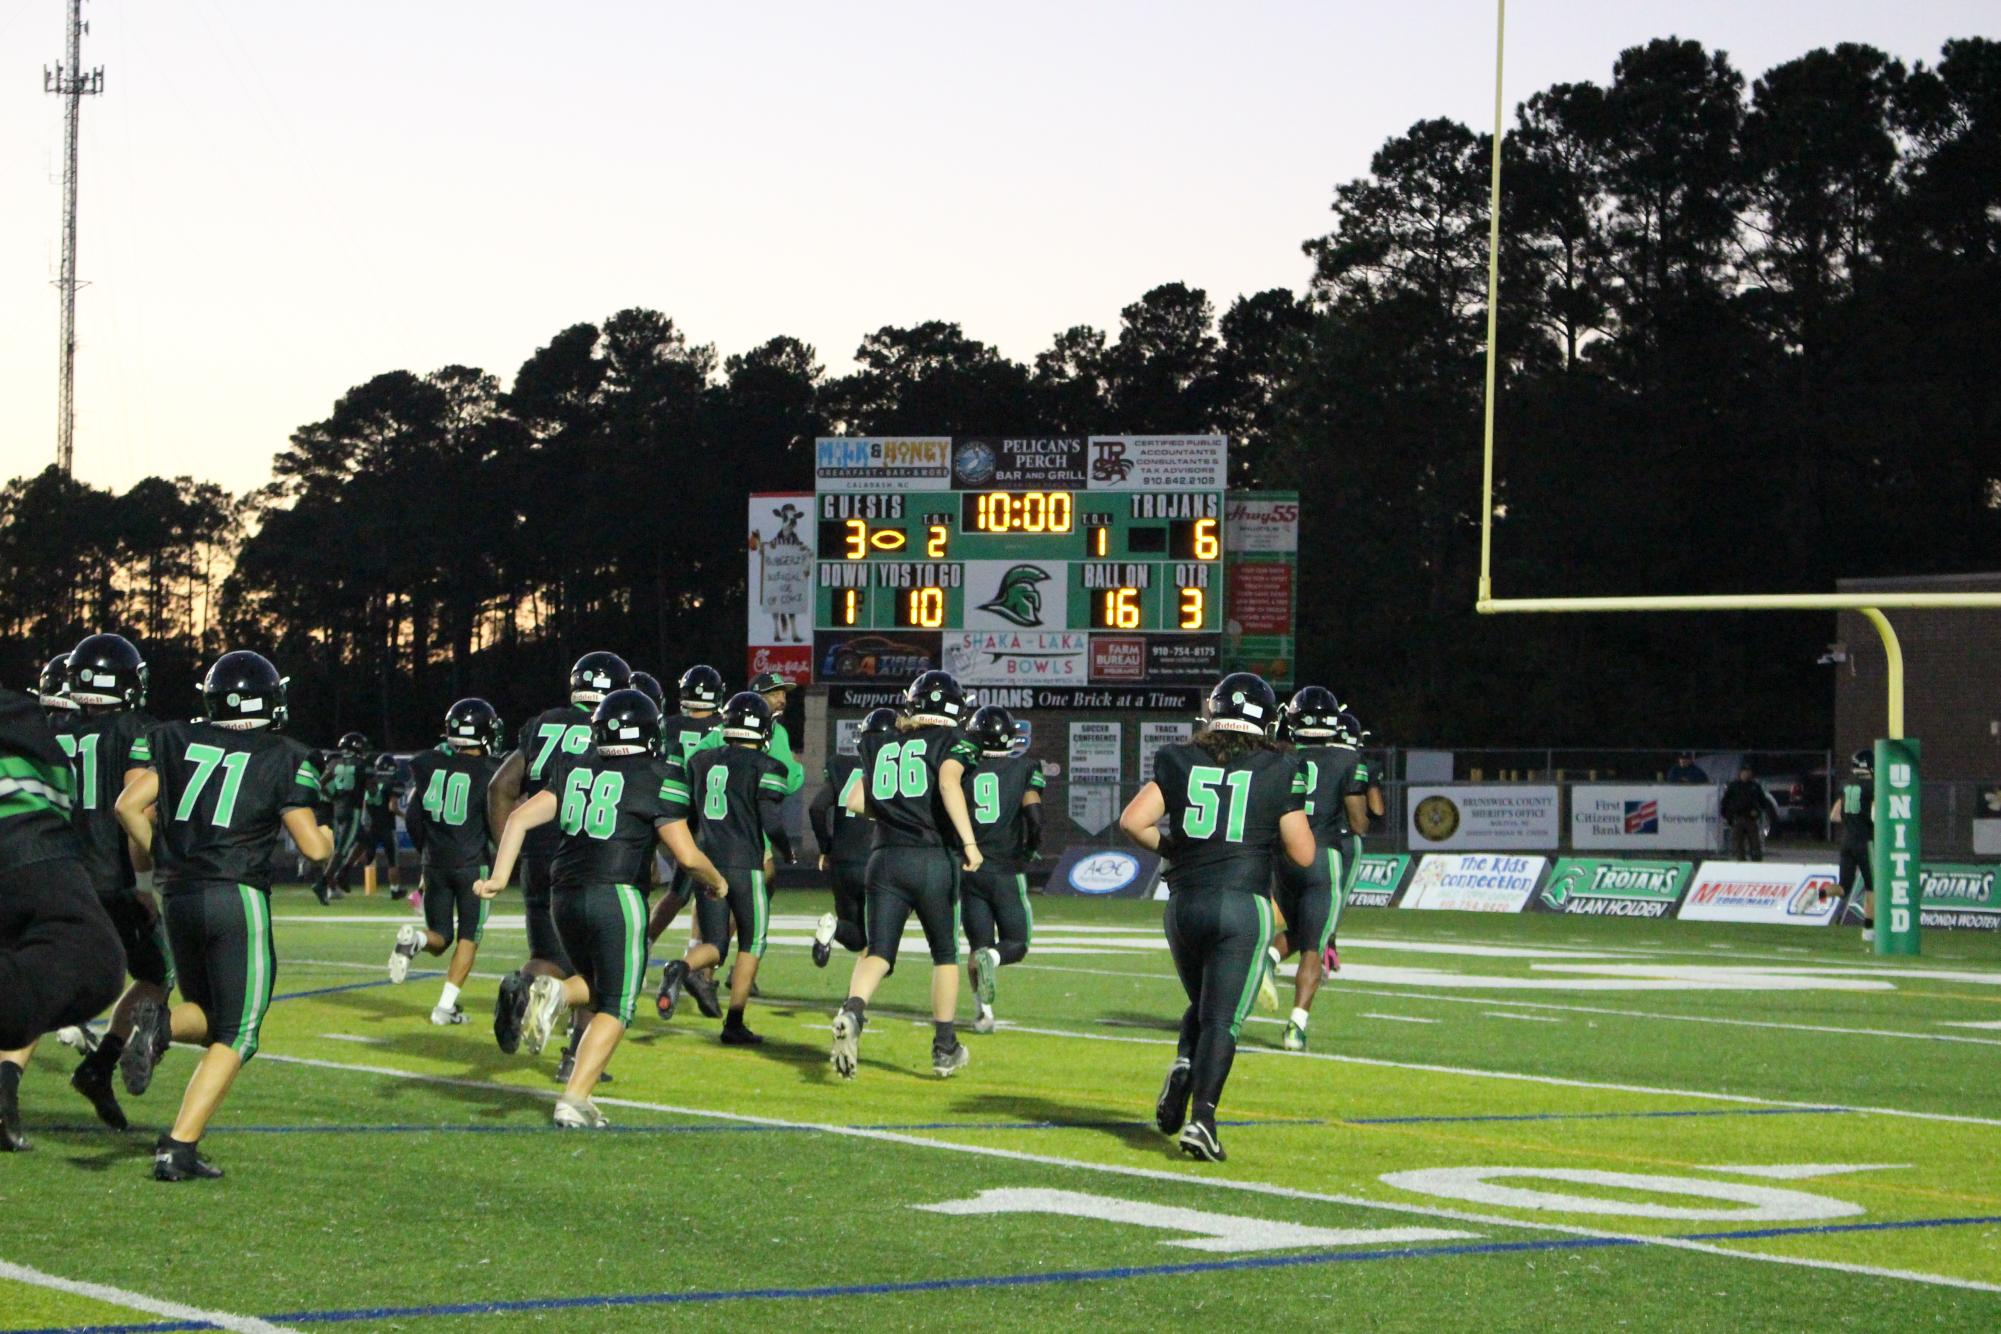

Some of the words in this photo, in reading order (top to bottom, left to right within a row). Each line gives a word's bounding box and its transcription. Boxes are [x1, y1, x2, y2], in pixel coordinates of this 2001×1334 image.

[871, 443, 882, 458] &
[884, 441, 950, 467] HONEY
[1003, 439, 1081, 453] PELICAN'S
[818, 468, 878, 477] BREAKFAST
[886, 468, 908, 477] BAR
[1016, 454, 1067, 468] PERCH
[995, 470, 1022, 480] BAR
[1024, 472, 1046, 480] AND
[1047, 470, 1086, 480] GRILL
[823, 495, 902, 519] GUESTS
[977, 492, 1071, 532] 10:00
[1131, 493, 1218, 518] TROJANS
[845, 519, 866, 560] 3
[927, 526, 947, 558] 2
[1098, 527, 1107, 556] 1
[1194, 519, 1218, 560] 6
[820, 563, 868, 588] DOWN
[880, 563, 911, 588] YDS
[915, 563, 935, 588] TO
[939, 563, 961, 588] GO
[1084, 563, 1121, 588] BALL
[1125, 563, 1149, 588] ON
[1175, 563, 1208, 588] QTR
[846, 589, 855, 625] 1
[910, 587, 943, 628] 10
[1105, 588, 1139, 629] 16
[1181, 588, 1203, 629] 3
[1096, 655, 1140, 665] BUREAU
[1108, 643, 1140, 655] FARM
[1152, 646, 1216, 656] 910-754-8175
[1007, 660, 1073, 674] BOWLS
[966, 688, 1034, 708] ROJANS
[1039, 691, 1069, 707] One
[1073, 691, 1113, 707] Brick
[1116, 692, 1132, 707] at
[1135, 696, 1144, 707] a
[1149, 691, 1186, 707] Time
[1073, 734, 1117, 742] CONFERENCE
[1081, 724, 1109, 733] SOCCER
[1155, 725, 1178, 733] TRACK
[1214, 721, 1250, 731] Riddell
[871, 738, 929, 801] 66
[174, 742, 251, 829] 71
[422, 768, 472, 826] 40
[703, 764, 730, 821] 8
[560, 766, 625, 841] 68
[973, 772, 1001, 824] 9
[1182, 765, 1254, 843] 51
[1463, 798, 1514, 806] BRUNSWICK
[1516, 798, 1553, 806] COUNTY
[1595, 800, 1620, 811] First
[1471, 809, 1514, 817] SHERIFF'S
[1515, 809, 1546, 817] OFFICE
[1575, 812, 1621, 824] Citizens
[1662, 813, 1698, 824] forever
[1592, 825, 1622, 836] Bank
[1888, 763, 1912, 933] UNITED
[1461, 857, 1487, 871] The
[1490, 857, 1529, 874] Kids
[1590, 865, 1680, 894] TROJANS
[1691, 882, 1794, 905] MINUTEMAN
[1565, 899, 1606, 914] ALAN
[1605, 900, 1668, 917] HOLDEN
[1957, 912, 2000, 929] WOOTEN
